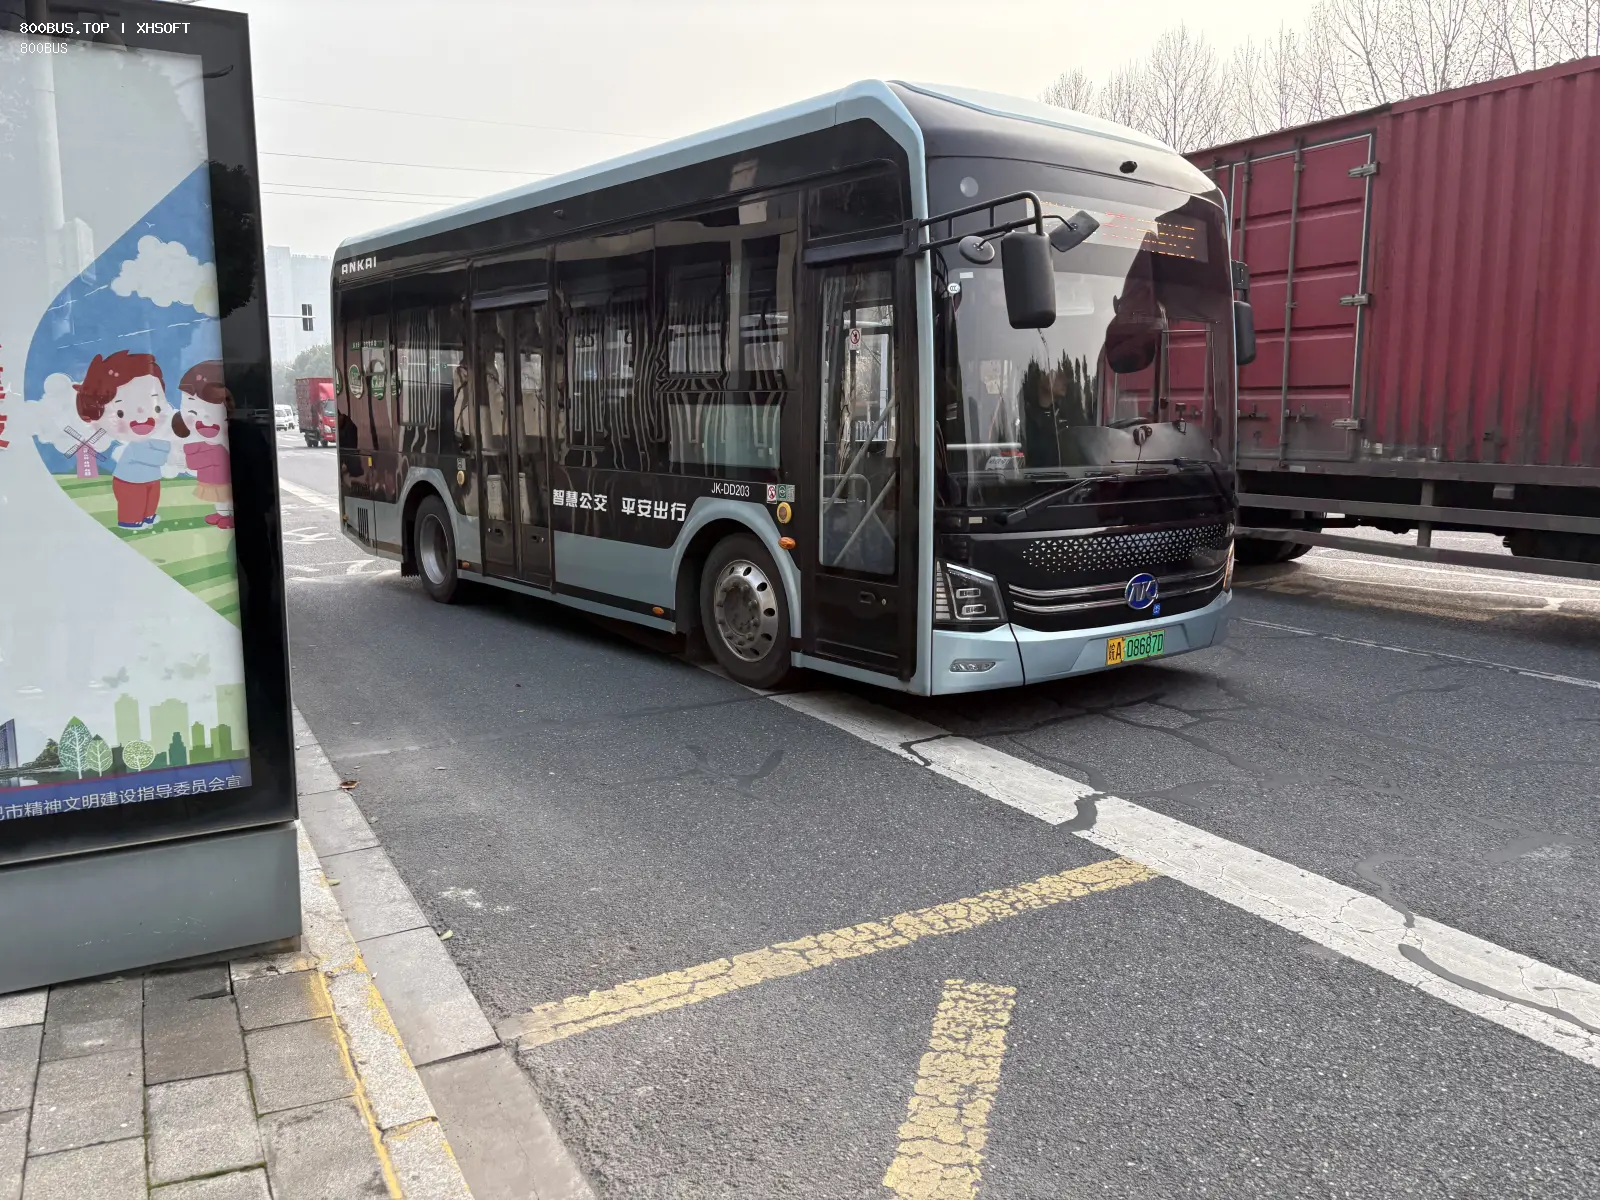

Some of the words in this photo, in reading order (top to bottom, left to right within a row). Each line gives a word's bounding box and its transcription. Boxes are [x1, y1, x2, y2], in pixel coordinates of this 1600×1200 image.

[341, 256, 377, 275] ANKAI
[711, 482, 750, 498] JK-DD203
[553, 489, 608, 512] 智慧公交
[621, 497, 687, 521] 平安出行
[0, 775, 242, 820] 市精神文明建设指导委员会宣
